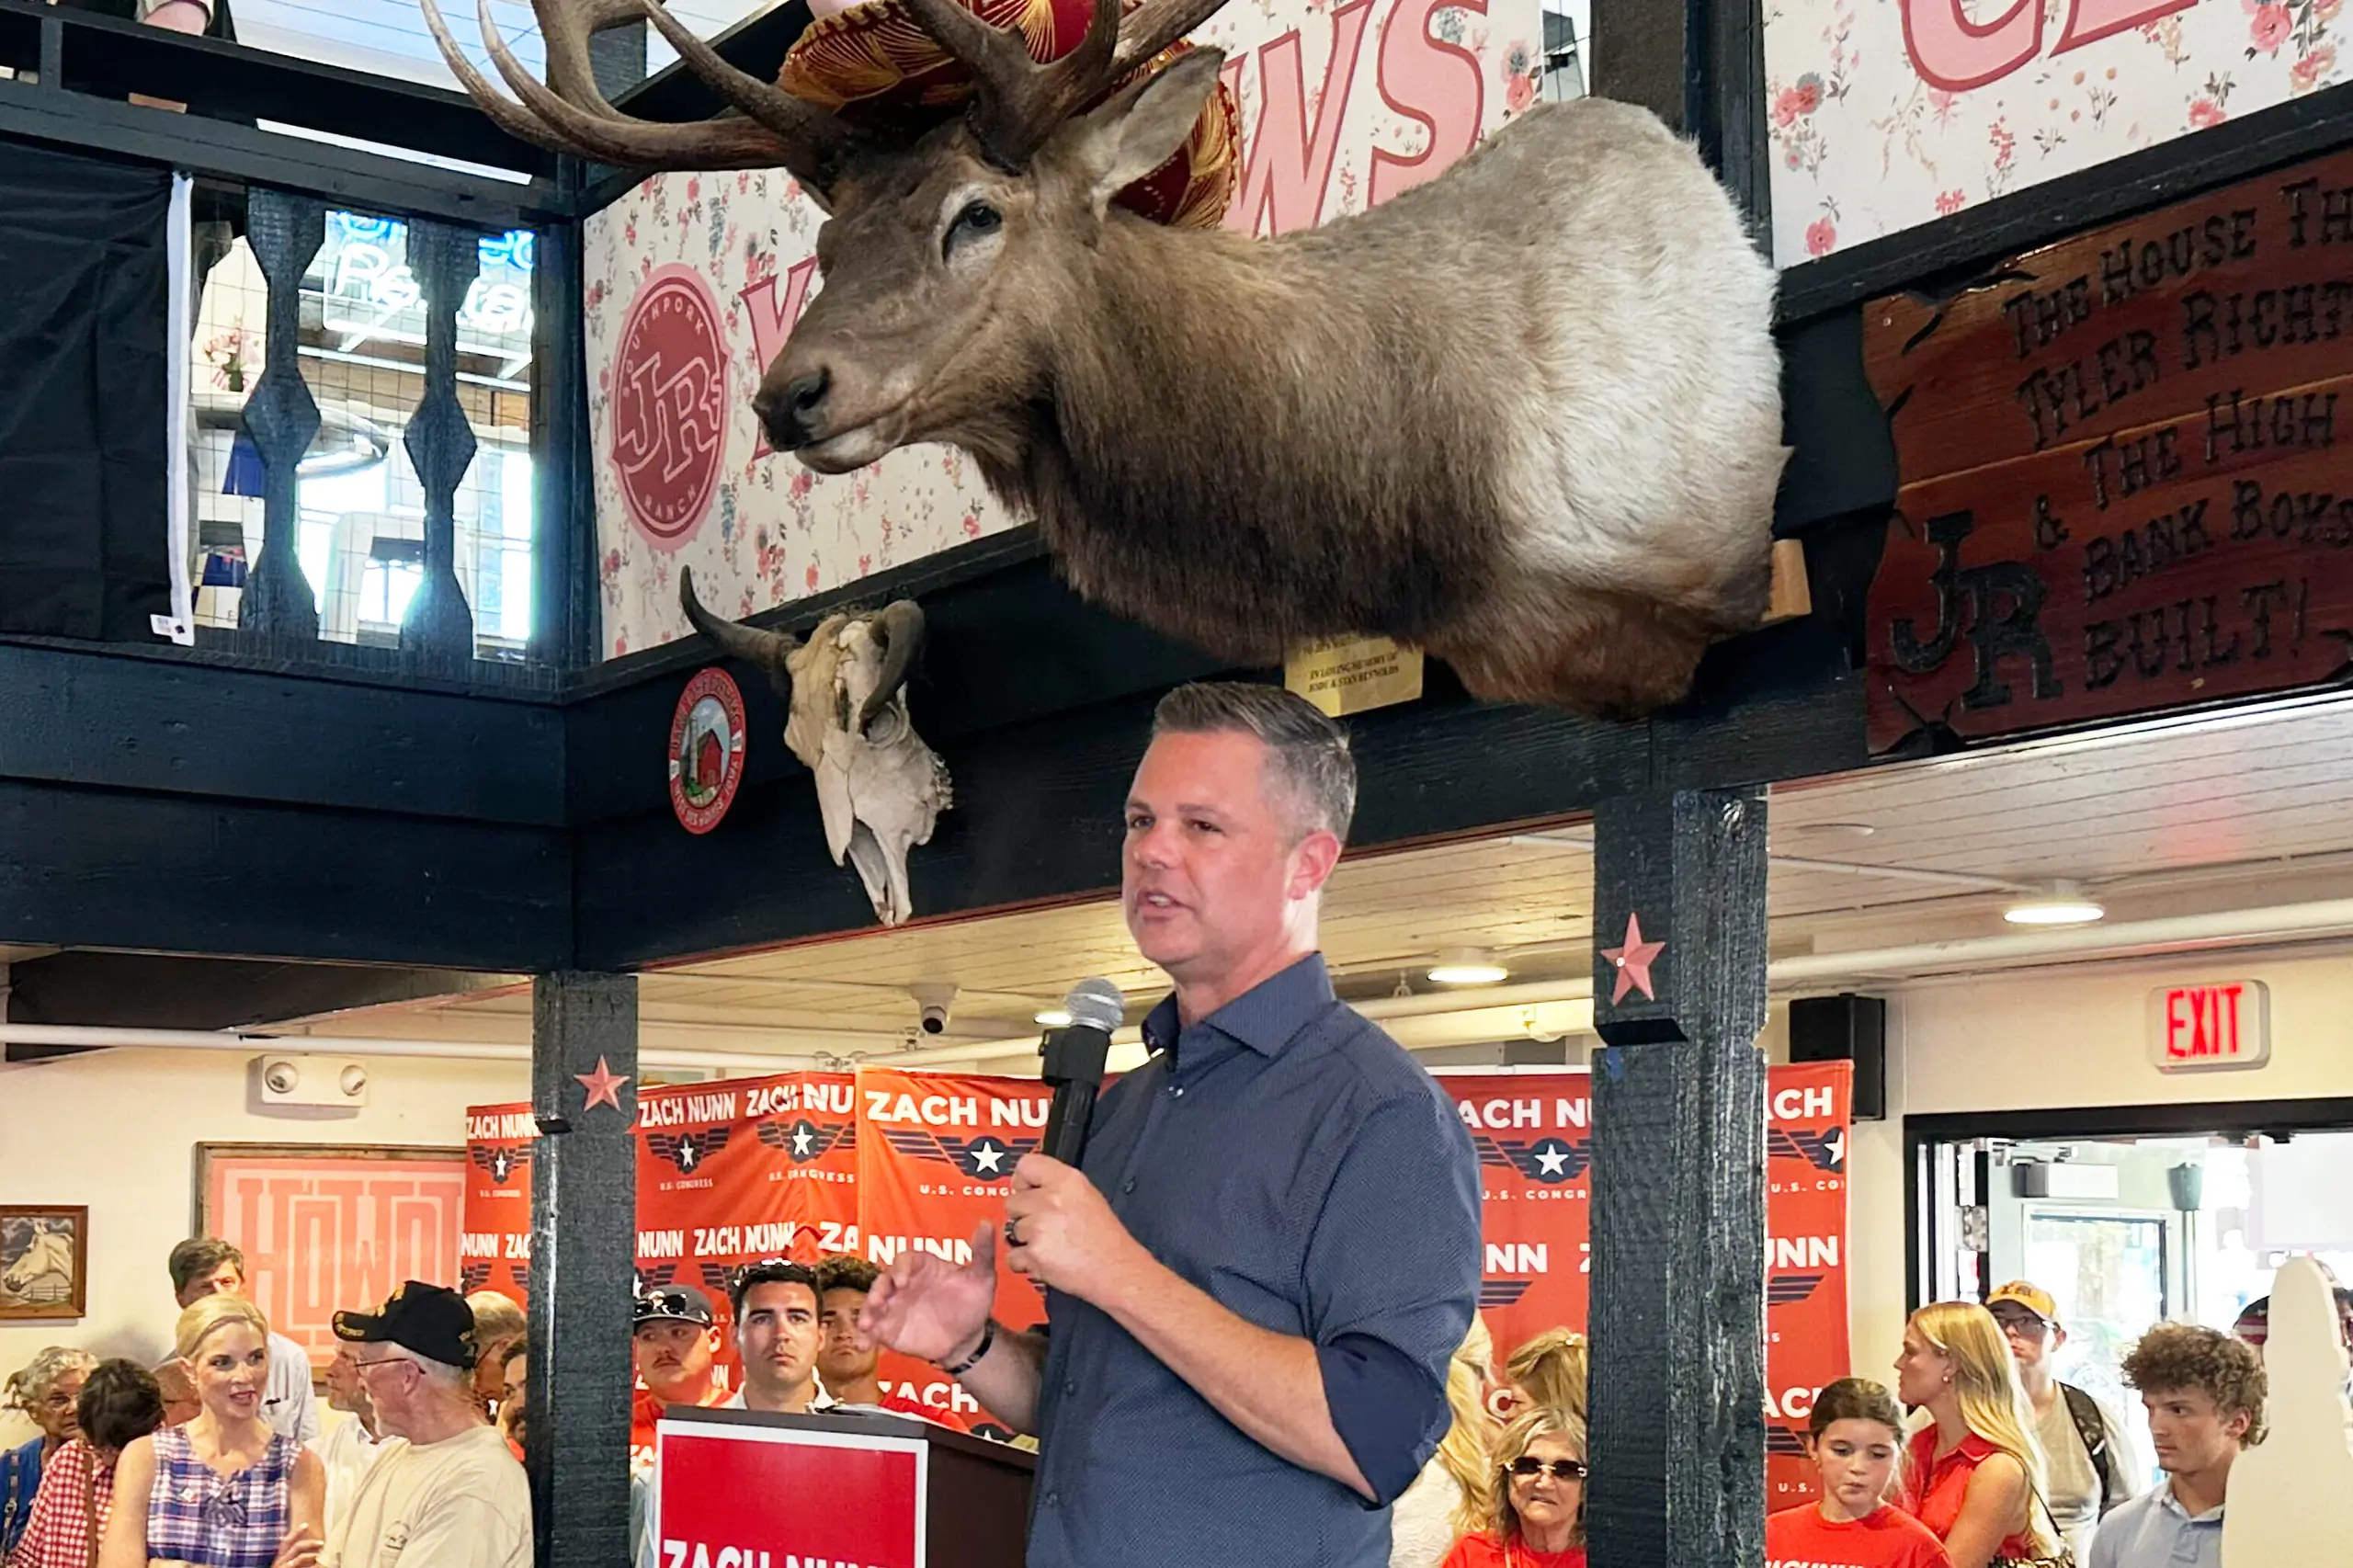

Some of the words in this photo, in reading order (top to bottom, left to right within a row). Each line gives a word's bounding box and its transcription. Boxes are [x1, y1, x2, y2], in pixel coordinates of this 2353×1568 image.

[2001, 275, 2090, 360] THE
[2099, 208, 2258, 309] HOUSE
[2015, 329, 2159, 451] TYLER
[2032, 494, 2071, 551] &
[2083, 436, 2182, 511] THE
[2204, 388, 2339, 463] HIGH
[2084, 497, 2215, 607] BANK
[1891, 509, 2063, 710] JR
[2165, 983, 2243, 1060] EXIT
[467, 1115, 499, 1139] ZACH
[638, 1098, 684, 1128] ZACH
[688, 1092, 736, 1123] NUNN
[865, 1091, 977, 1126] ZACH
[991, 1097, 1050, 1127] NU
[1556, 1098, 1591, 1129] N
[920, 1184, 954, 1196] U.S.
[962, 1185, 1017, 1197] CONG
[1770, 1182, 1807, 1194] U.S.
[461, 1233, 499, 1258] NUNN
[638, 1230, 684, 1258] NUNN
[694, 1225, 740, 1257] ZACH
[744, 1221, 796, 1255] NUNN
[1778, 1482, 1815, 1493] U.S.
